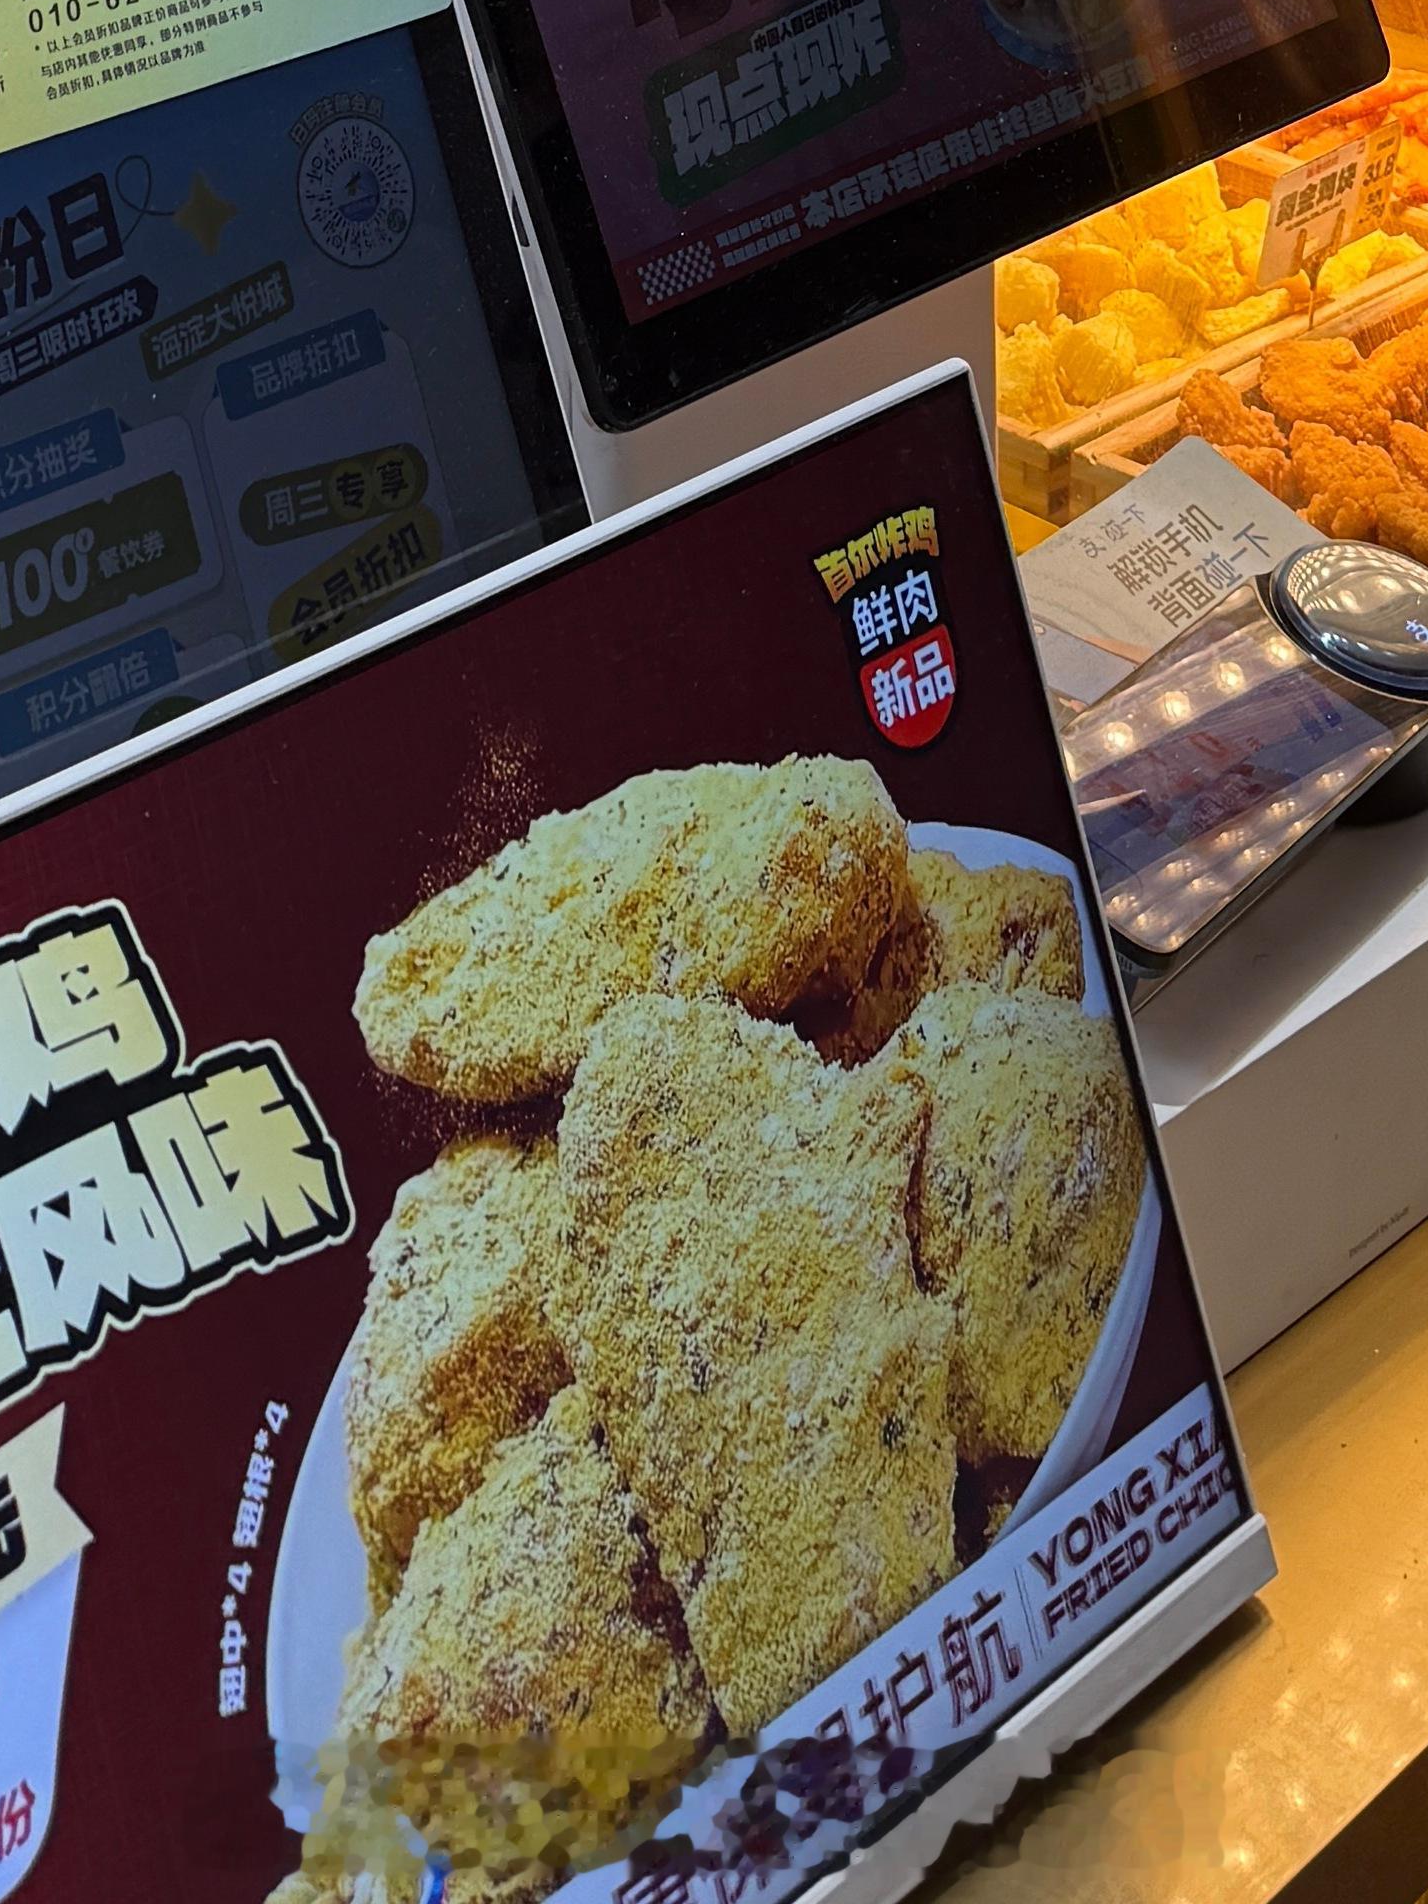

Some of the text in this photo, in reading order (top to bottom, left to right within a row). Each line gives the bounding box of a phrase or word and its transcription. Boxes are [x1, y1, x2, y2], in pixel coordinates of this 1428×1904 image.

[150, 272, 285, 370] 海淀大悦城
[250, 333, 362, 399] 品牌折扣
[263, 453, 410, 528] 周三专享
[98, 532, 166, 581] 餐饮券
[289, 522, 425, 644] 会员折扣
[813, 506, 940, 604] 首尔炸鸡
[1105, 503, 1225, 597] 解锁手机
[851, 569, 938, 656] 鲜肉
[24, 658, 150, 733] 积分翻倍
[871, 640, 955, 728] 新品
[1029, 1466, 1152, 1589] YONG
[1042, 1526, 1154, 1639] FRIED
